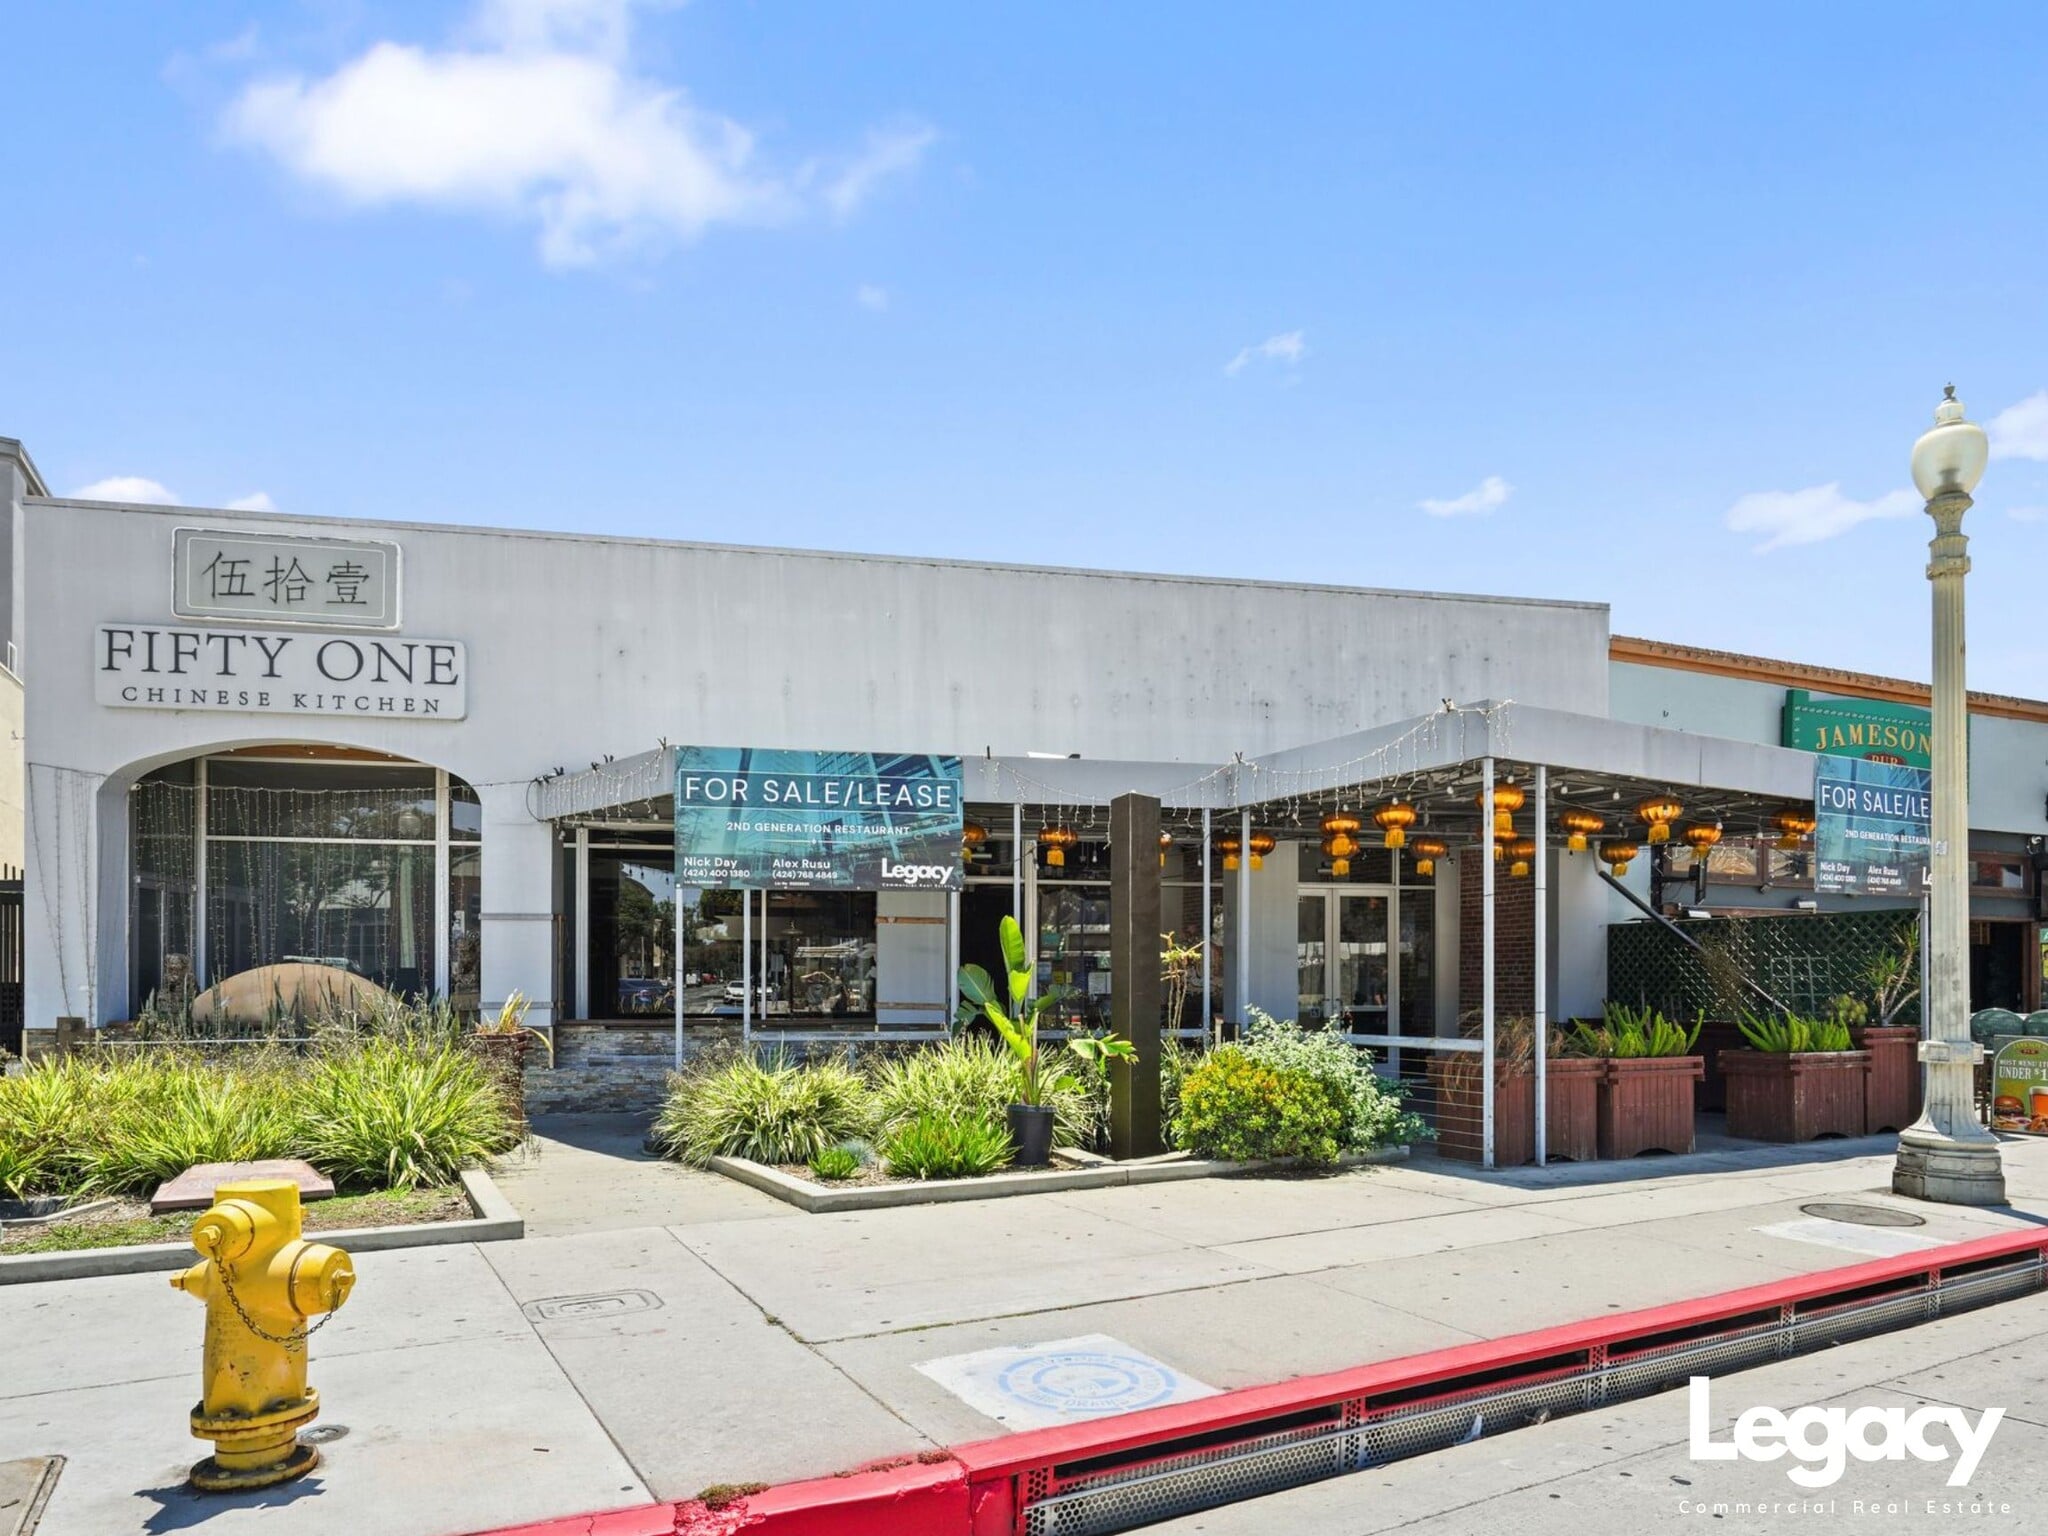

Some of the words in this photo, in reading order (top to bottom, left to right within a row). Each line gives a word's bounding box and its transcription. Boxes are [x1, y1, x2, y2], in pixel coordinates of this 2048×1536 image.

[201, 551, 370, 605] 伍拾壹
[101, 629, 293, 678] FIFTY
[316, 640, 459, 686] ONE
[121, 686, 271, 707] CHINESE
[293, 693, 440, 713] KITCHEN
[685, 777, 749, 801] FOR
[763, 779, 952, 808] SALE/LEASE
[1821, 785, 1856, 810] FOR
[1863, 789, 1932, 819] SALE/LE
[726, 822, 750, 831] 2ND
[754, 822, 831, 834] GENERATION
[835, 824, 910, 835] RESTAURANT
[1860, 831, 1899, 842] GENERATION
[1901, 834, 1931, 845] RESTAURA
[684, 857, 711, 866] Nick
[714, 857, 738, 869] Day
[773, 859, 799, 868] Alex
[802, 859, 831, 868] Rusu
[882, 858, 954, 884] Legacy
[1999, 1066, 2031, 1080] UNDER
